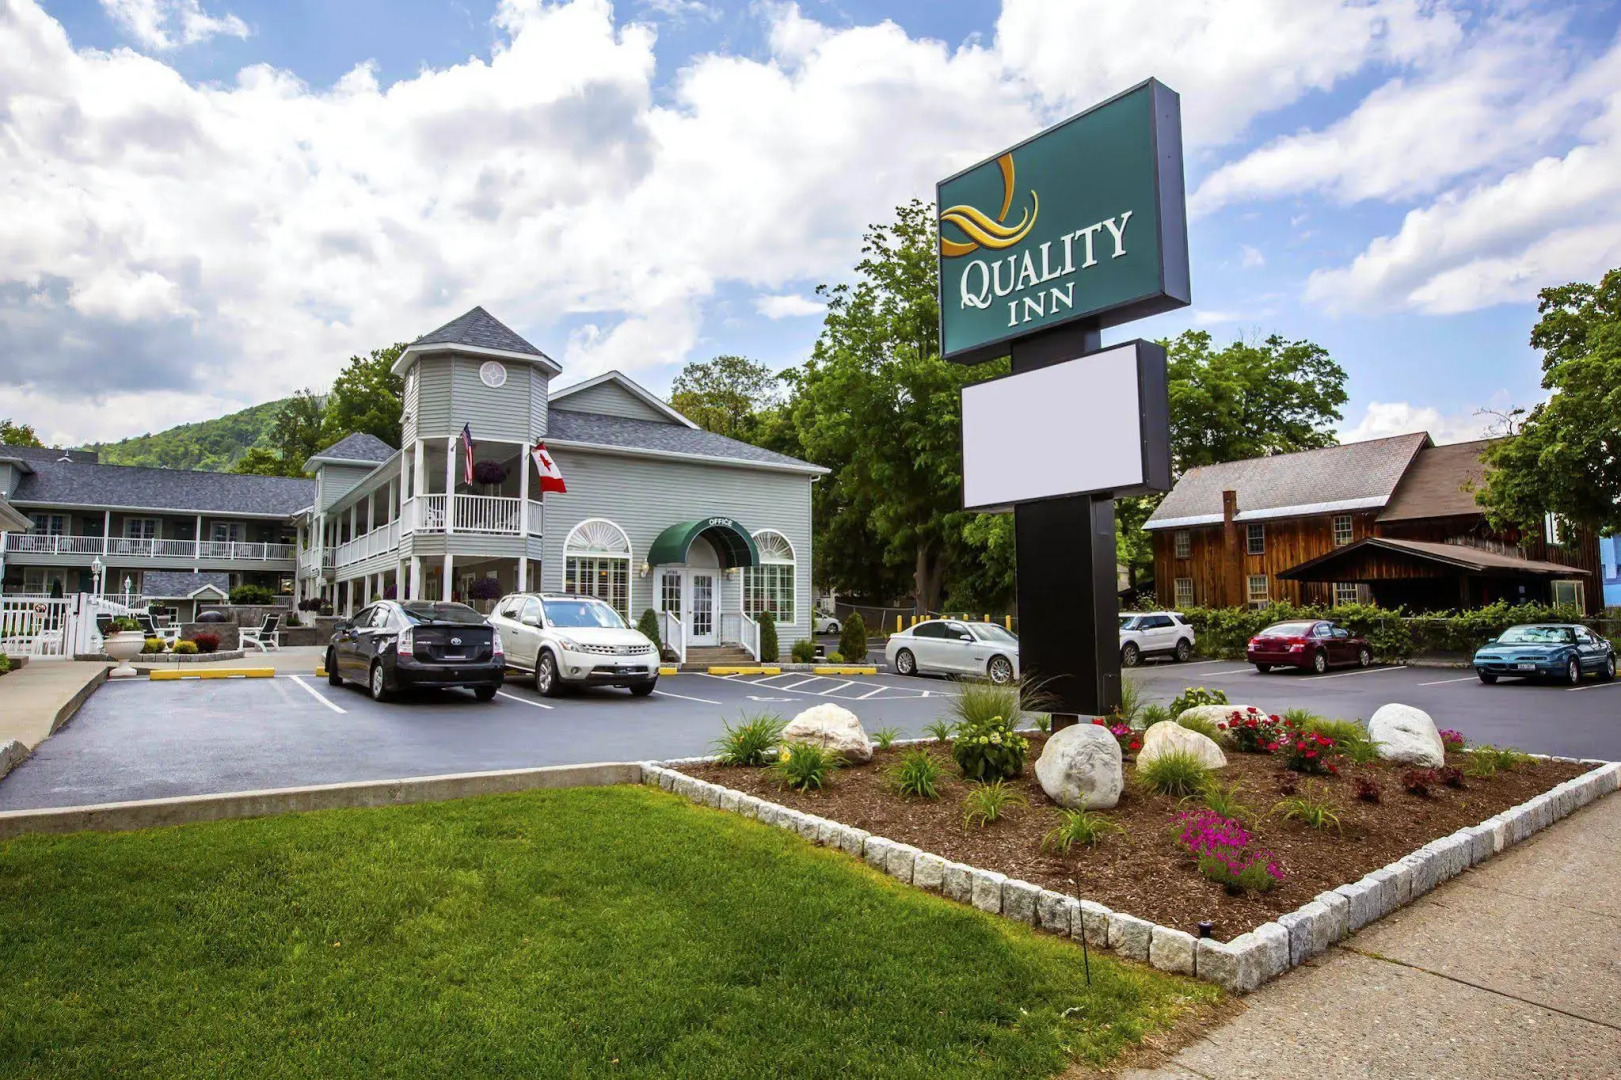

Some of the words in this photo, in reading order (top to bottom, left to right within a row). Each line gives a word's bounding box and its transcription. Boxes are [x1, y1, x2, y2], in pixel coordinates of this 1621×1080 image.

[960, 210, 1133, 310] QUALITY
[1007, 281, 1076, 327] INN
[709, 517, 733, 527] OFFICE
